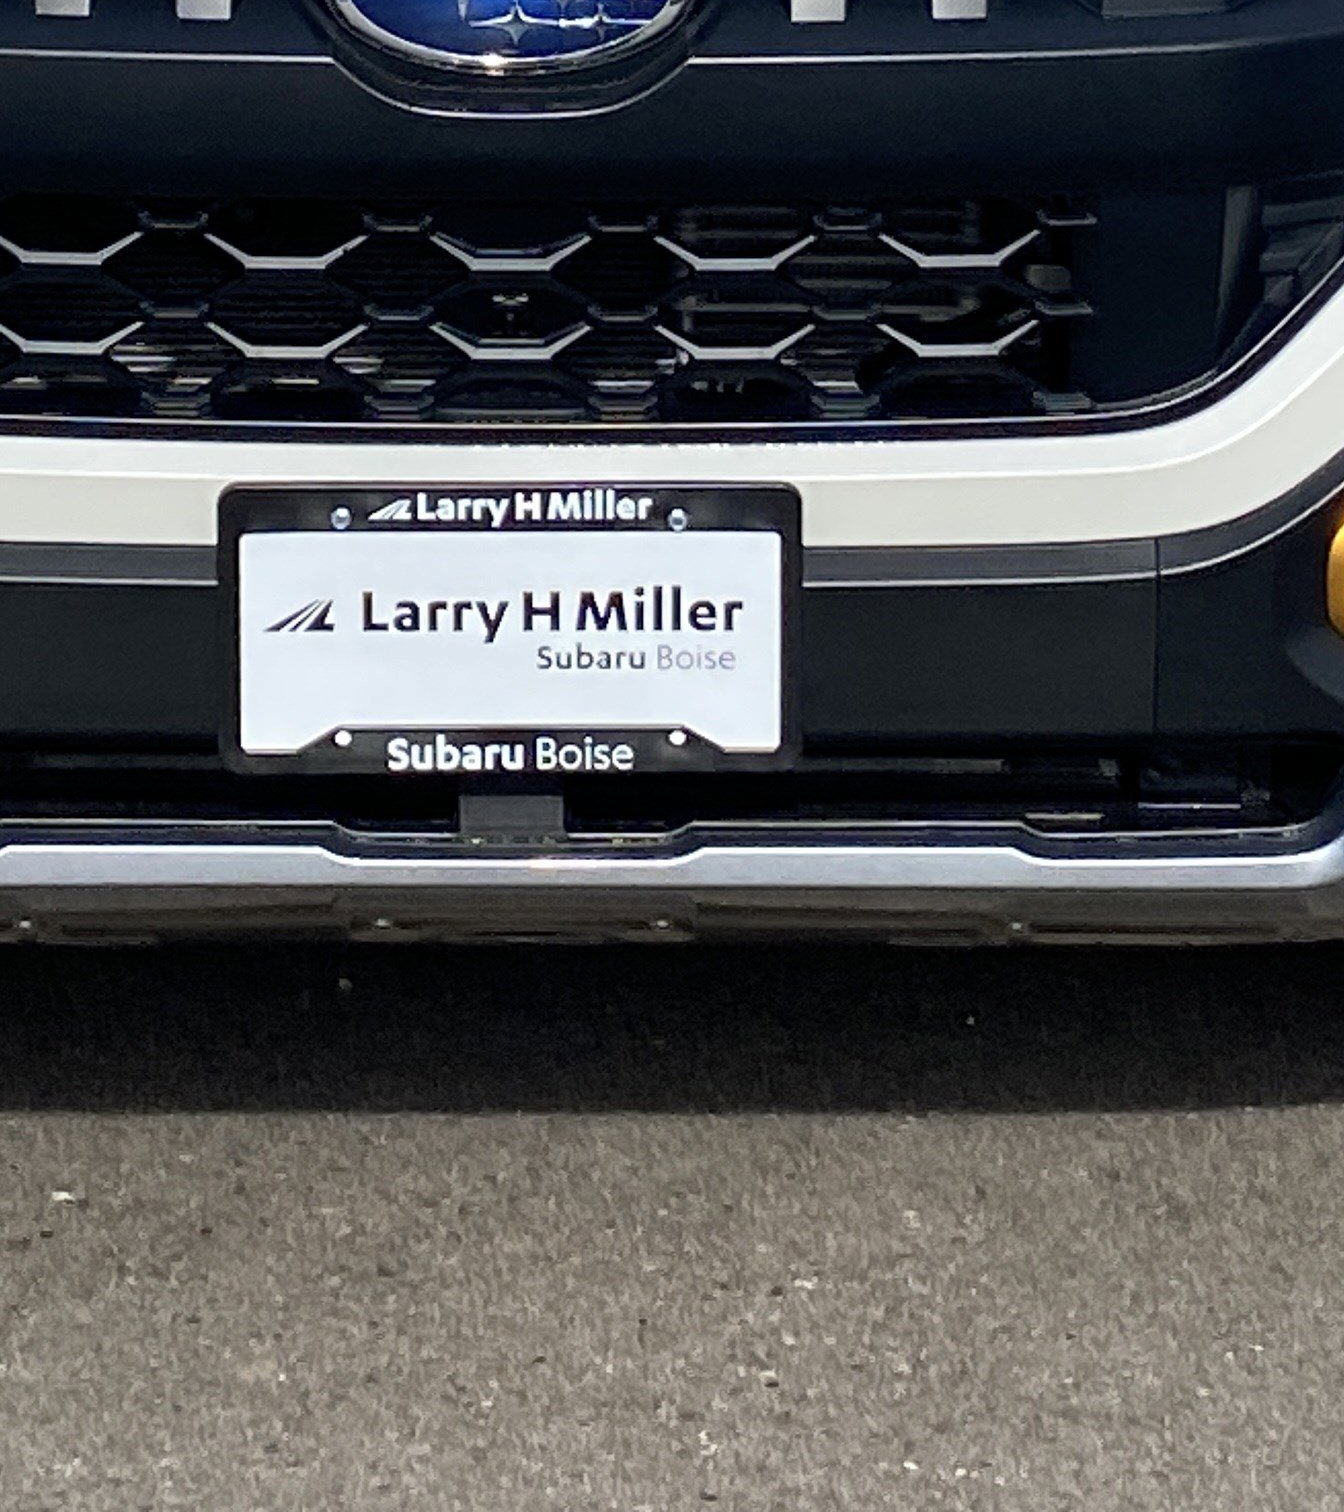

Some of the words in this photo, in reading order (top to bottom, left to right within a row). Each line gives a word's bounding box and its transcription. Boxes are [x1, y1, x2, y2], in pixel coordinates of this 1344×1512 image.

[416, 491, 510, 528] Larry
[514, 491, 542, 521] H
[546, 488, 653, 521] Miller
[361, 591, 510, 644] Larry
[522, 591, 561, 632] H
[575, 584, 744, 632] Miller
[536, 642, 646, 671] Subaru
[656, 643, 737, 671] Boise
[386, 733, 525, 771] Subaru
[534, 735, 635, 771] Boise
